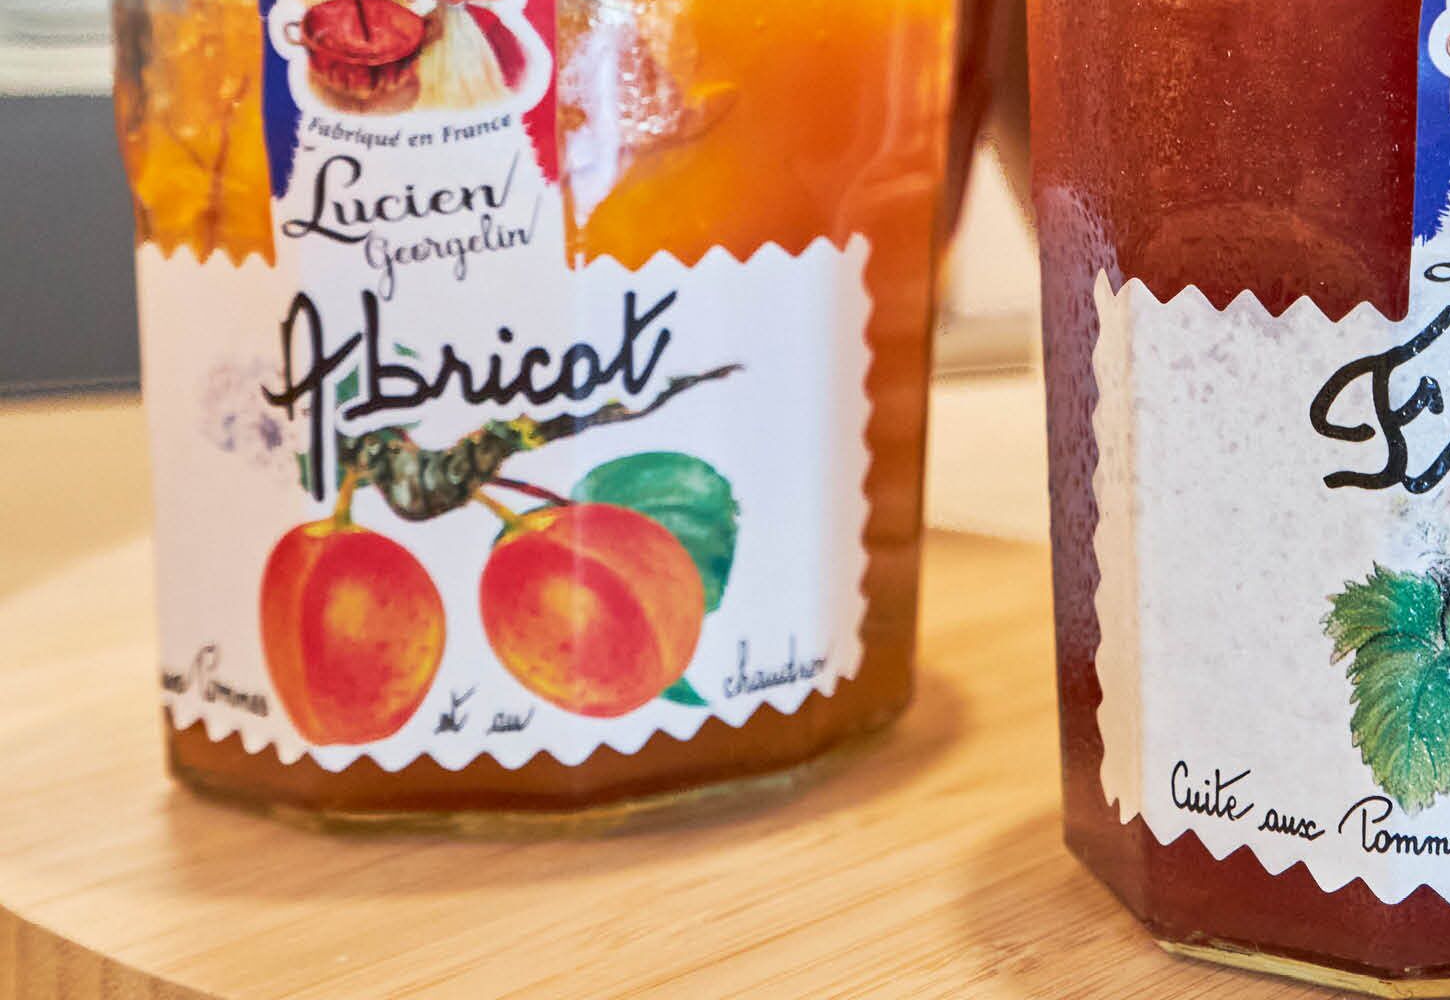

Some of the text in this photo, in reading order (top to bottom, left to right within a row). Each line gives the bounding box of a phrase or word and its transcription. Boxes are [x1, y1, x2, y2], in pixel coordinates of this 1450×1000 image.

[308, 113, 512, 151] Fabriqué en France
[281, 151, 519, 245] Lucien
[364, 194, 541, 300] Georgelin
[261, 289, 678, 500] Abricot
[1170, 760, 1254, 822] Cuite
[1257, 807, 1325, 842] aux
